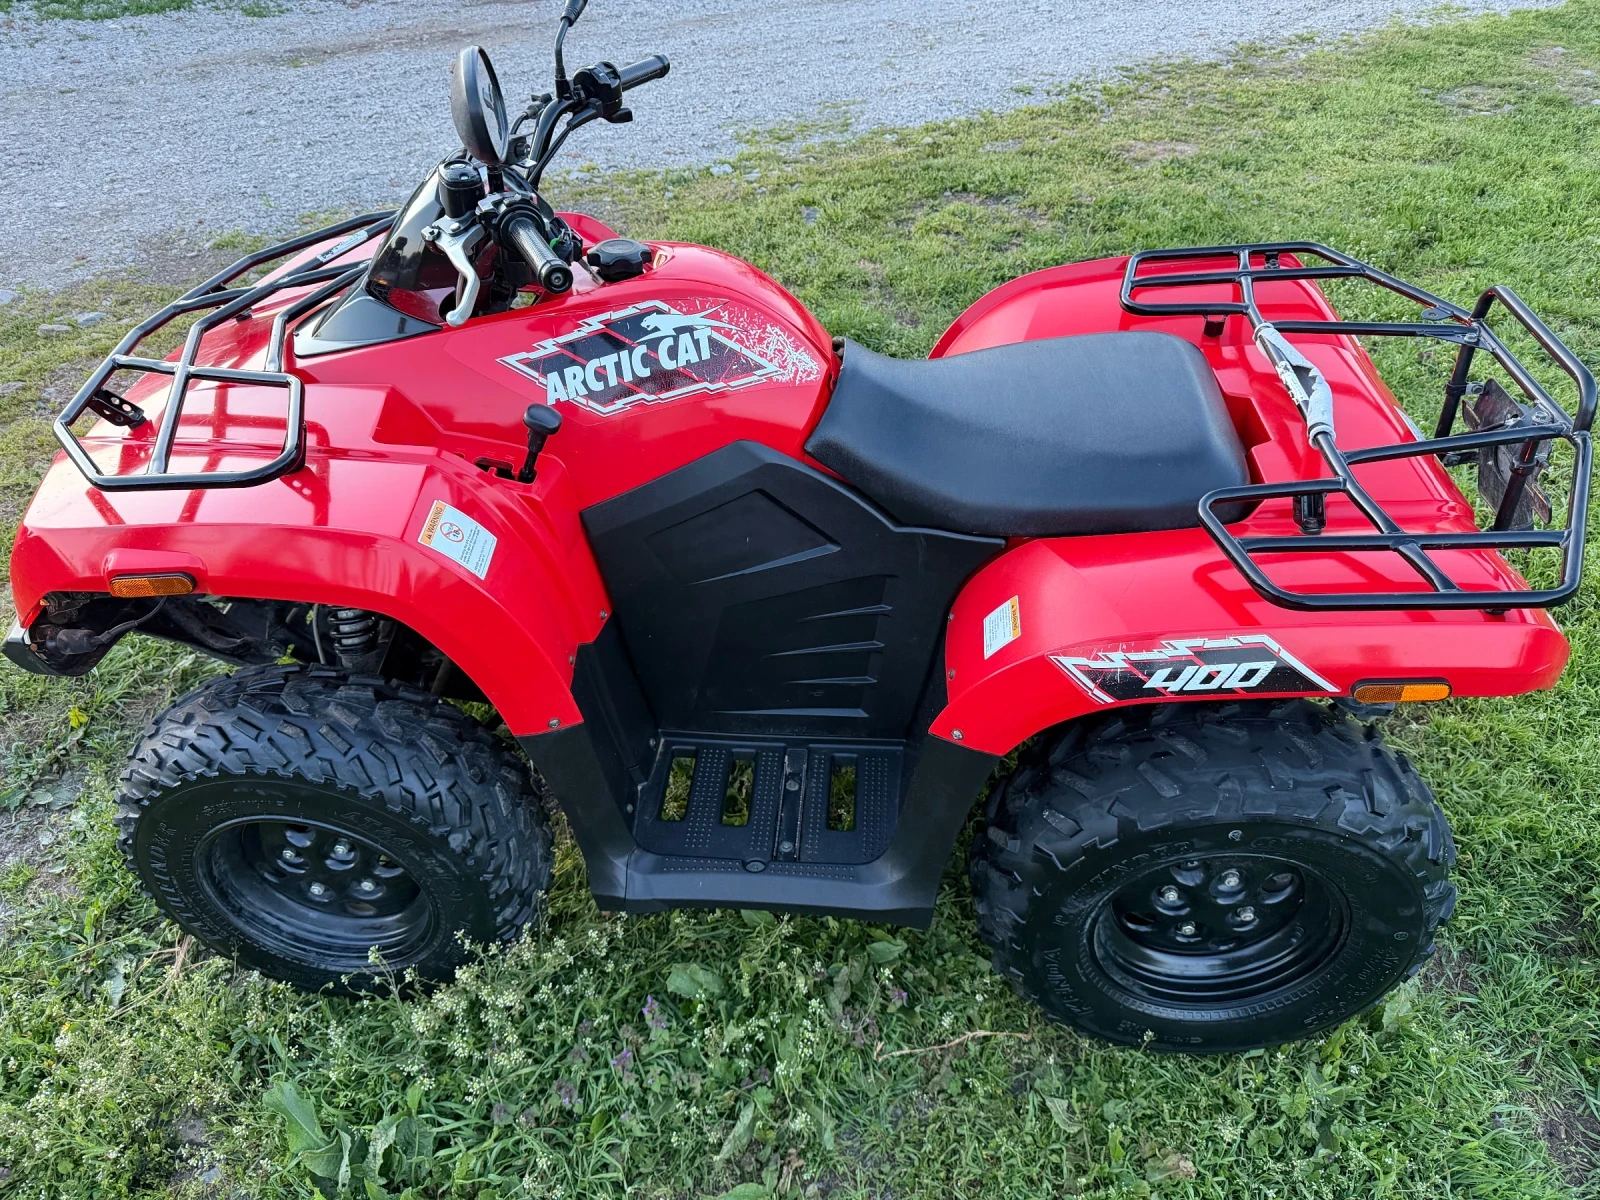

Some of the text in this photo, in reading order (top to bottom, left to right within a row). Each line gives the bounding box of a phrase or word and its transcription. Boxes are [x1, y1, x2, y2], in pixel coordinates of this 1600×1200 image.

[546, 344, 651, 405] ARCTIC
[657, 328, 713, 371] CAT
[428, 506, 443, 534] WARNING
[1143, 660, 1277, 691] 400
[1043, 947, 1094, 1016] KENDA
